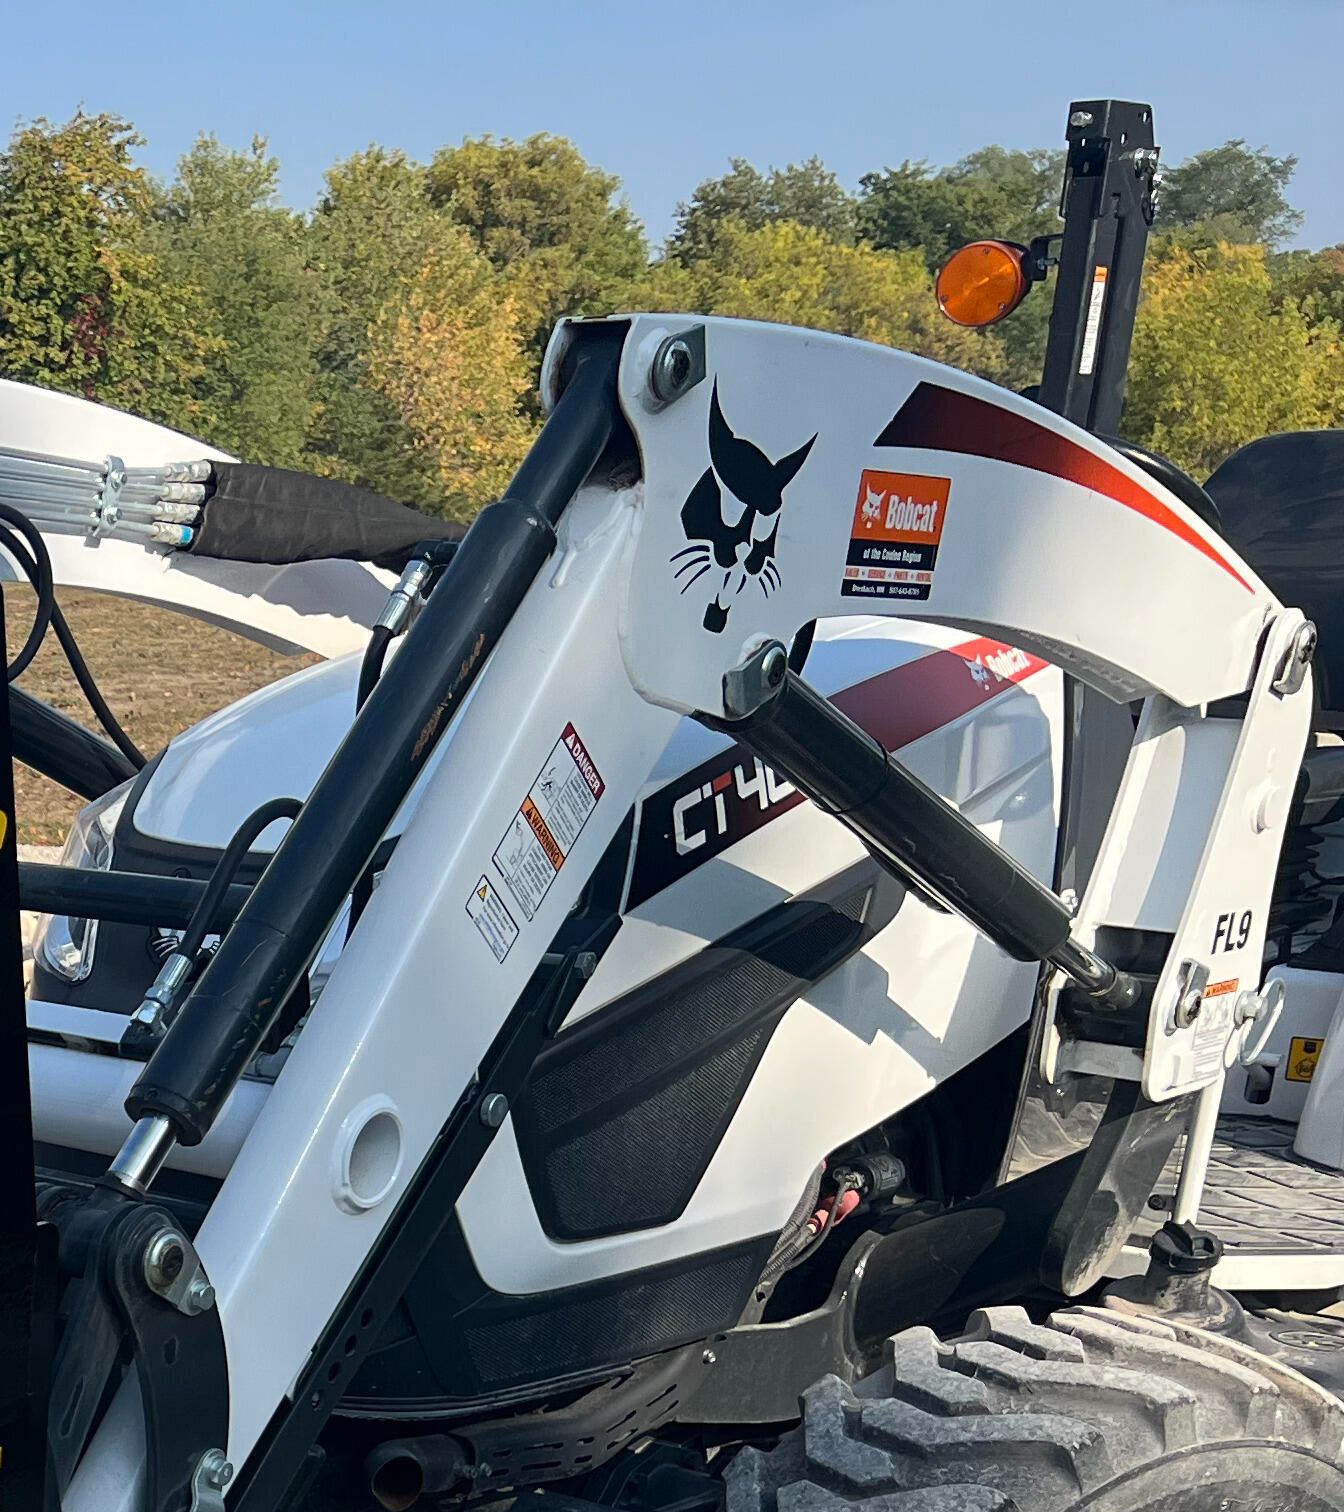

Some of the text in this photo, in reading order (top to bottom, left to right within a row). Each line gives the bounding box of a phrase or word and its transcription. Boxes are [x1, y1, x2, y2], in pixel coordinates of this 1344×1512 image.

[885, 494, 938, 533] Bobcat
[573, 742, 601, 794] DANGER
[531, 814, 561, 865] WARNING
[1210, 910, 1253, 955] FL9
